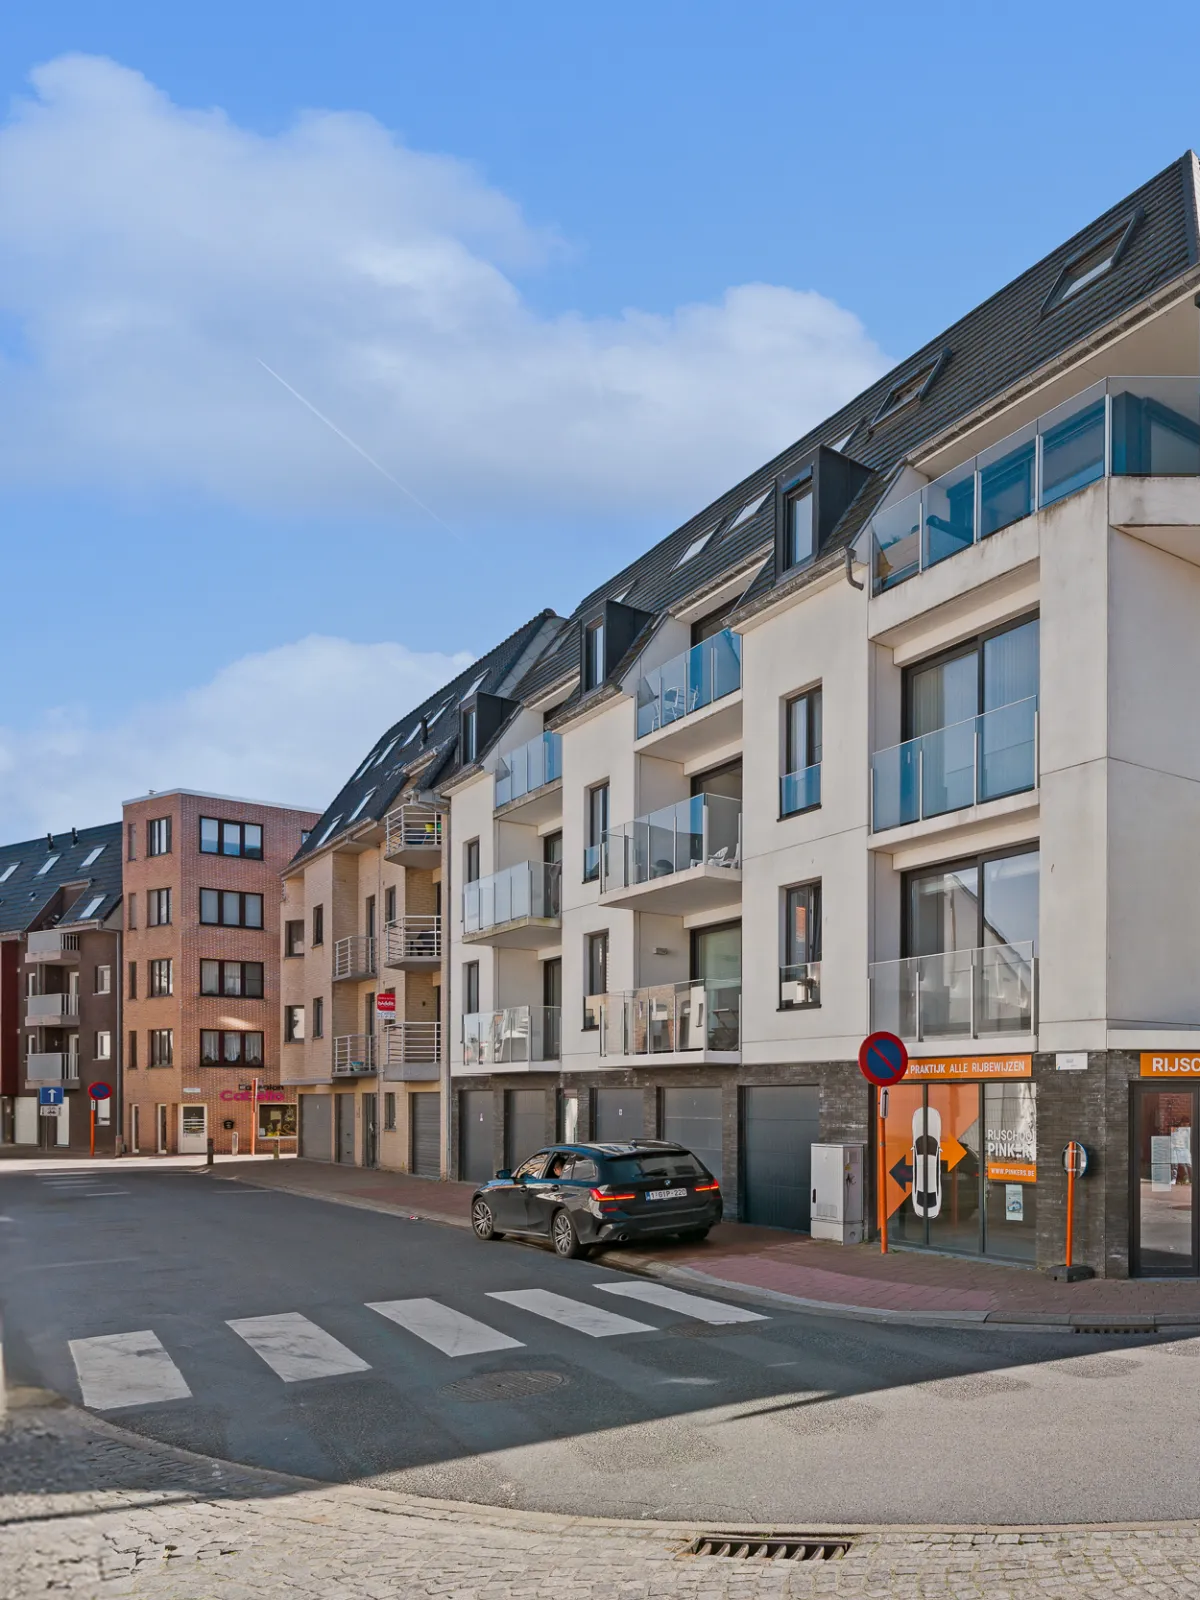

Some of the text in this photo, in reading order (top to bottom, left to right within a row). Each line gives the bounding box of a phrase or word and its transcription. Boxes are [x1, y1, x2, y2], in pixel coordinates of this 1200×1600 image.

[910, 1060, 1025, 1074] PRAKTIJK ALLE RIJBEWIJZEN
[991, 1168, 1035, 1177] WWW.PINKERS.BE
